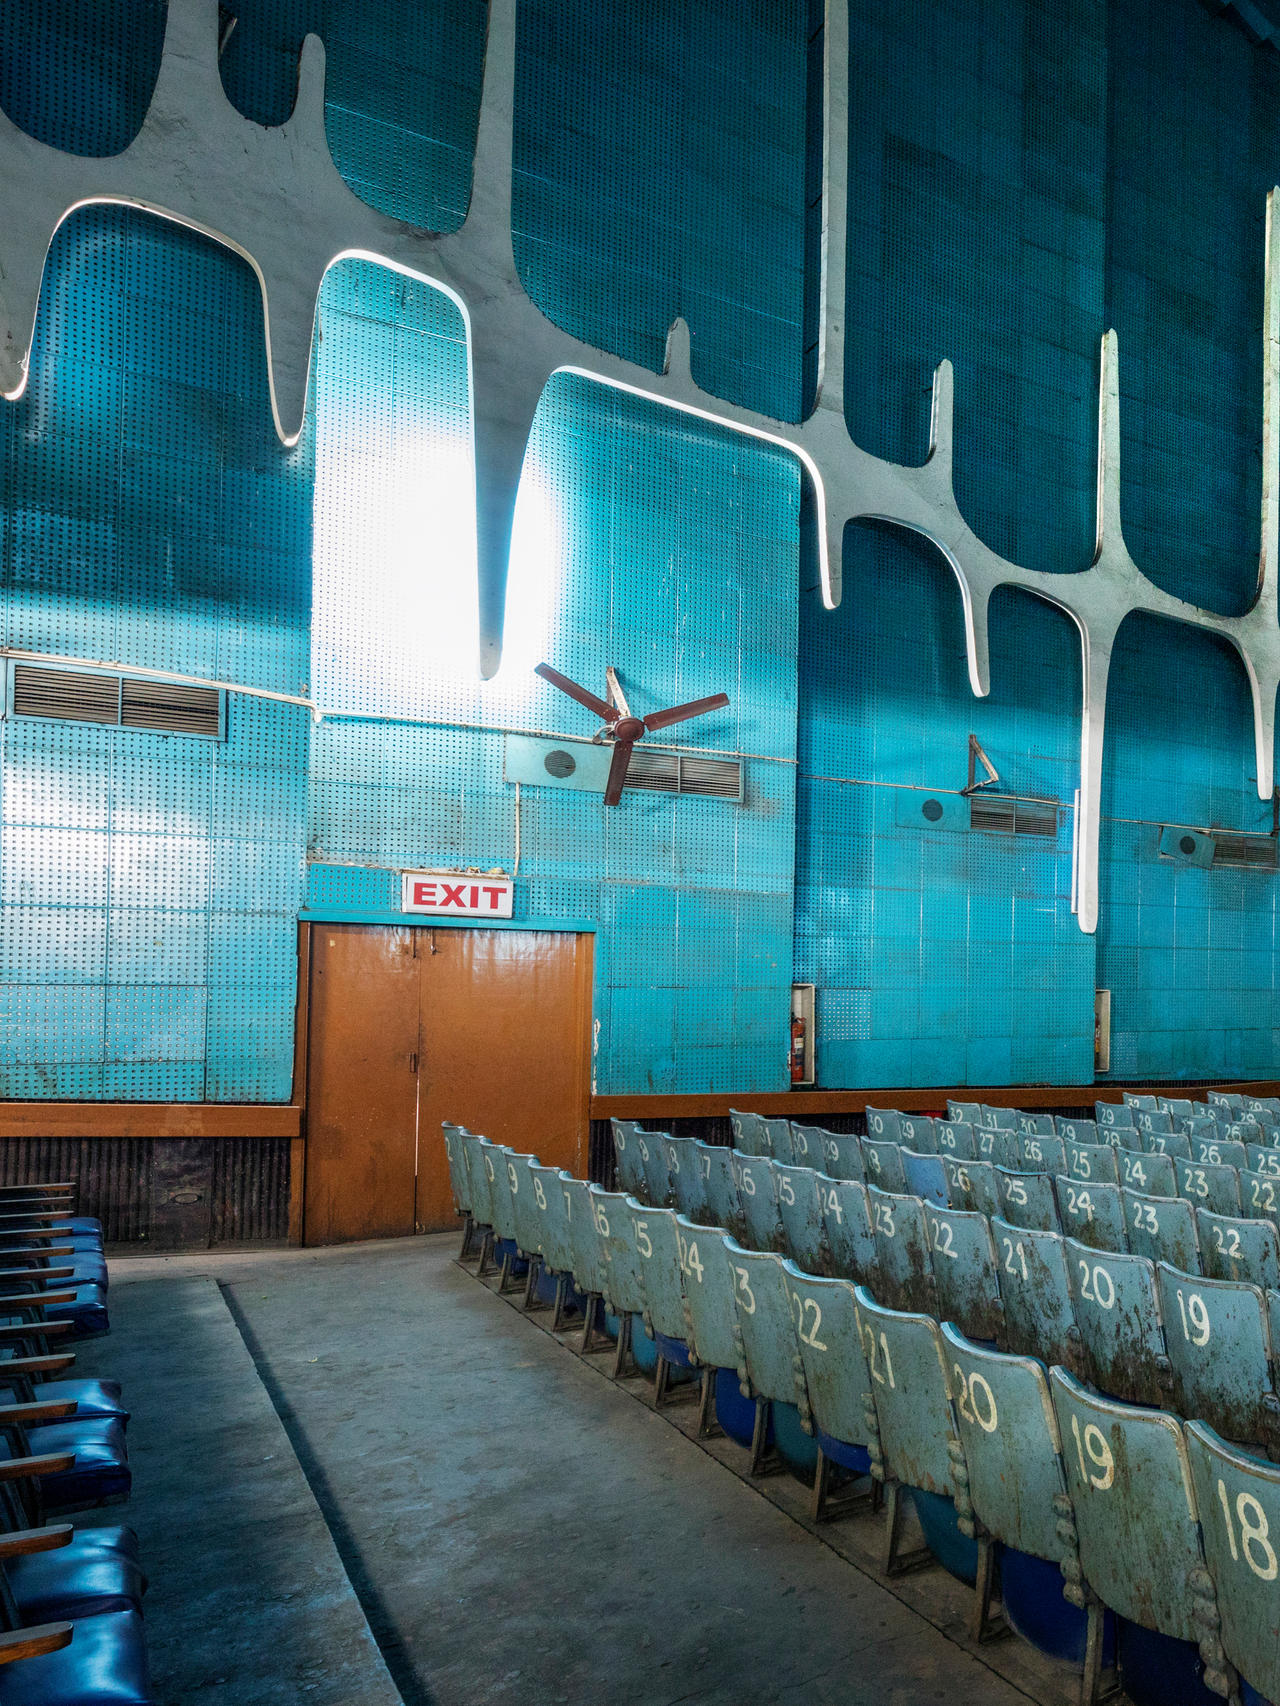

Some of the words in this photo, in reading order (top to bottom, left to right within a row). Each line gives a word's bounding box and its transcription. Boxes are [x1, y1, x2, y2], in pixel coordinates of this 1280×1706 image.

[413, 883, 507, 909] EXIT
[869, 1114, 883, 1133] 30
[902, 1119, 914, 1139] 29
[987, 1113, 997, 1129] 31
[1101, 1108, 1114, 1124] 29
[1139, 1114, 1152, 1131] 28
[940, 1126, 956, 1148] 28
[980, 1133, 994, 1154] 27
[1024, 1140, 1042, 1161] 26
[1150, 1136, 1166, 1153] 27
[1072, 1149, 1091, 1178] 25
[1200, 1144, 1221, 1165] 26
[1258, 1154, 1280, 1175] 25
[951, 1164, 970, 1192] 26
[1124, 1158, 1147, 1186] 24
[1184, 1168, 1209, 1197] 23
[777, 1173, 795, 1206] 25
[1005, 1177, 1028, 1205] 25
[1251, 1180, 1277, 1212] 22
[820, 1187, 842, 1224] 24
[874, 1202, 895, 1238] 23
[1067, 1187, 1095, 1223] 24
[1133, 1201, 1159, 1235] 23
[931, 1217, 958, 1258] 22
[1212, 1226, 1244, 1260] 22
[680, 1237, 704, 1283] 24
[1003, 1237, 1028, 1281] 21
[1079, 1260, 1115, 1309] 20
[793, 1292, 827, 1351] 22
[1177, 1290, 1210, 1346] 19
[865, 1325, 895, 1388] 21
[954, 1363, 998, 1432] 20
[1071, 1413, 1115, 1490] 19
[1218, 1479, 1278, 1581] 18
